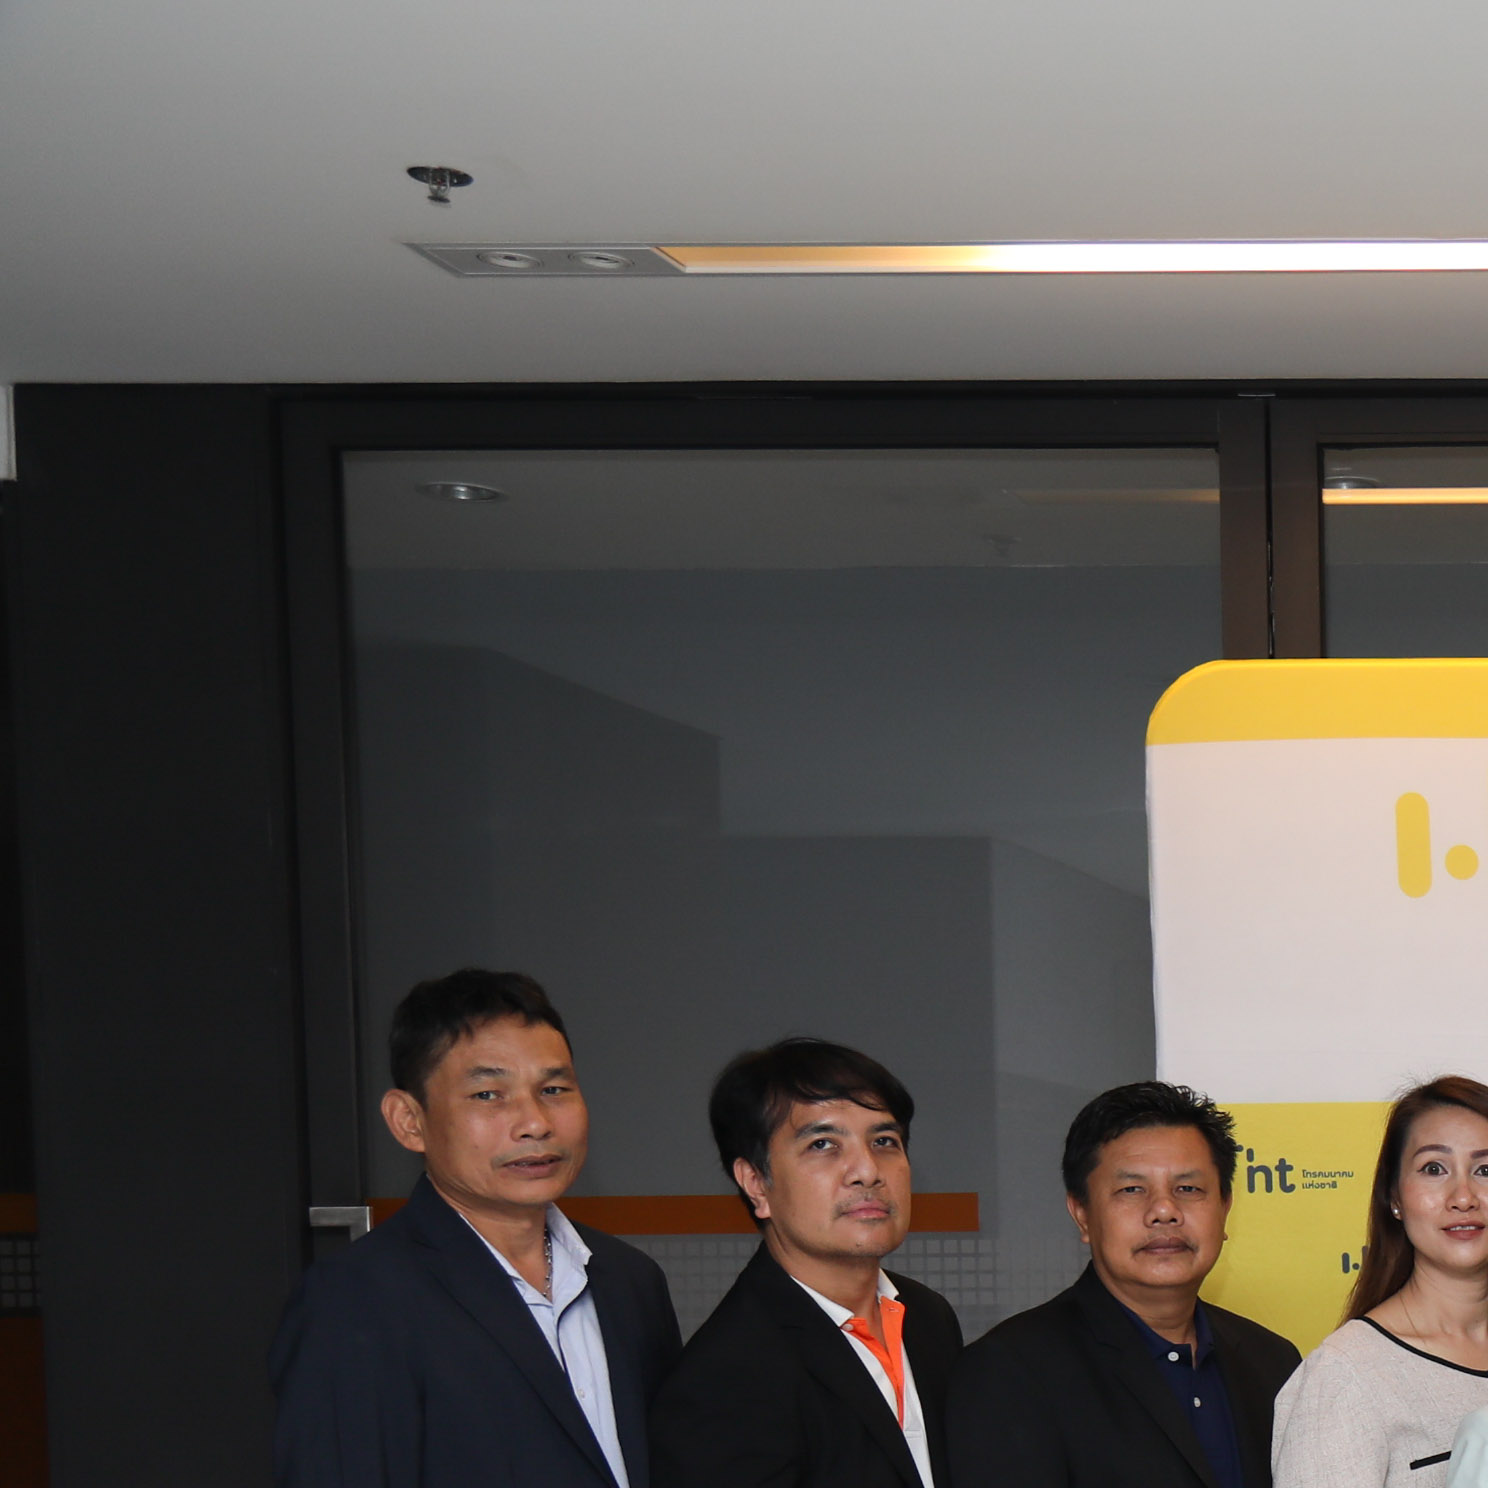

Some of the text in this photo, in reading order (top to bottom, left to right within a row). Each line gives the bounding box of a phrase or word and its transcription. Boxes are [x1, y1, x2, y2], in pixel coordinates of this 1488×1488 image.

[1246, 1157, 1296, 1194] nt
[1302, 1169, 1355, 1179] โทรคมนาคม
